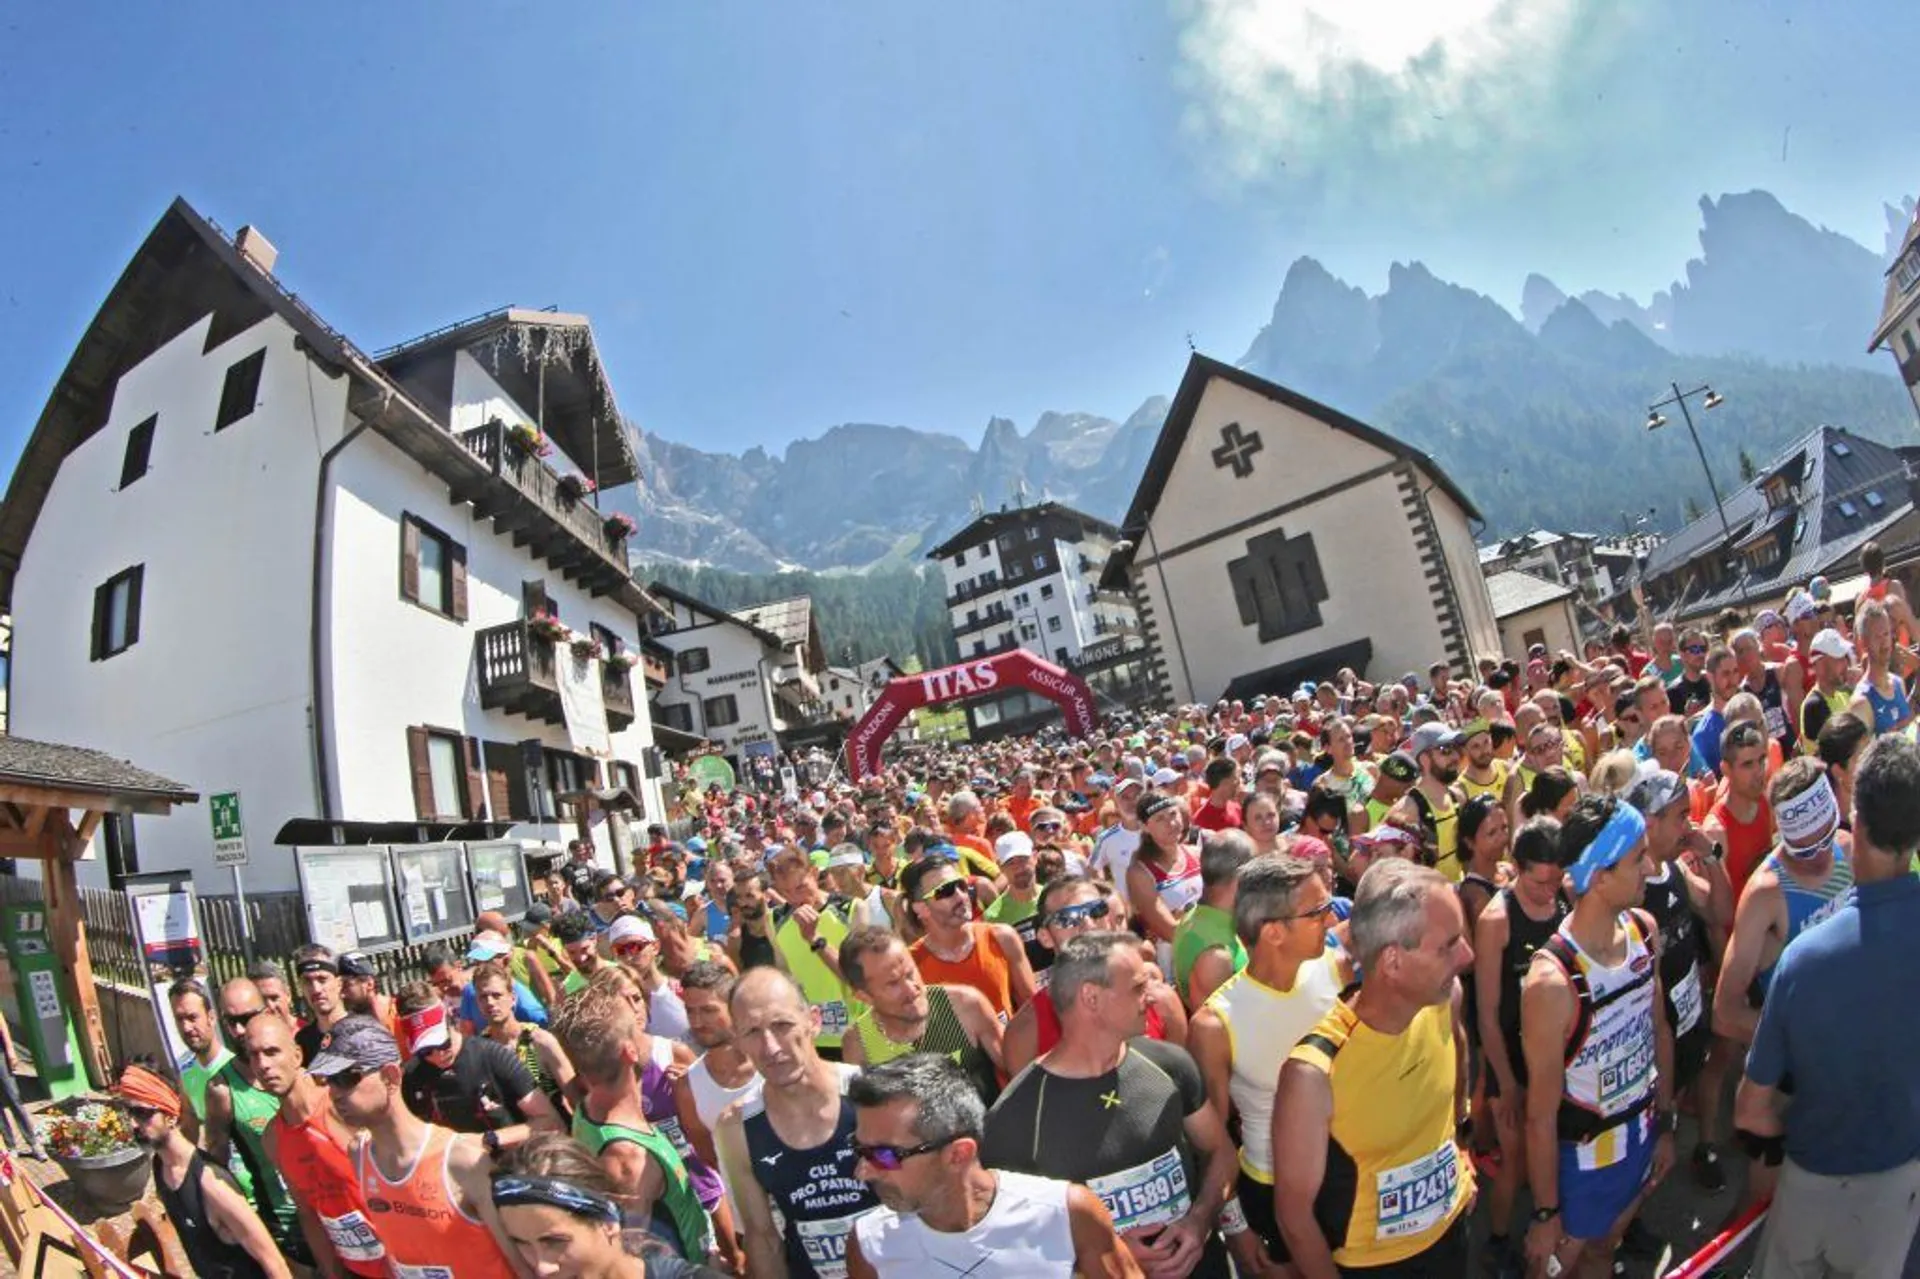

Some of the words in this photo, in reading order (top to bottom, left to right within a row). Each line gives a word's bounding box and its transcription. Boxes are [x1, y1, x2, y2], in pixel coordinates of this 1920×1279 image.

[921, 660, 998, 701] ITAS
[809, 1164, 838, 1179] CUS
[790, 1183, 817, 1204] PRO
[820, 1178, 870, 1193] PATRIA
[804, 1192, 861, 1210] MILANO
[1117, 1175, 1171, 1217] 1589
[1403, 1168, 1447, 1213] 1243
[393, 1200, 453, 1220] Bisson
